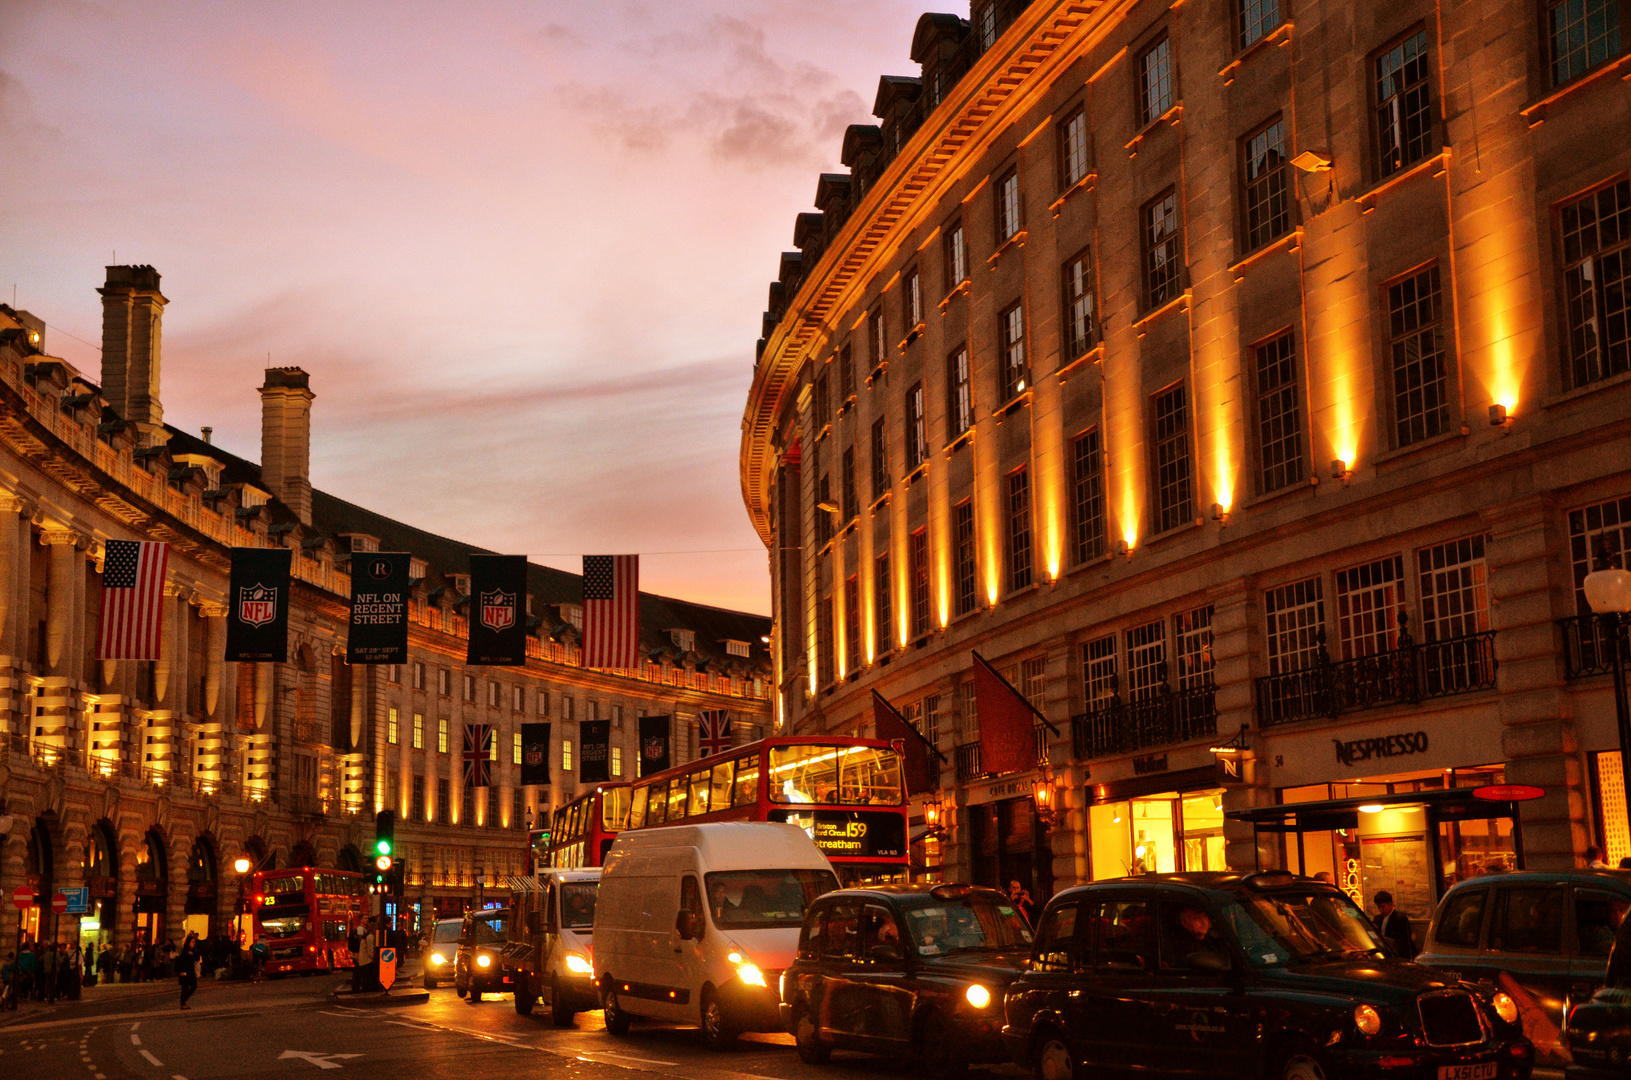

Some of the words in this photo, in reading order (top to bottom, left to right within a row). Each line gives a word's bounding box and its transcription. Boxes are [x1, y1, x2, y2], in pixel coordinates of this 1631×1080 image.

[375, 563, 388, 575] R
[357, 594, 380, 603] NFL
[383, 593, 401, 603] ON
[243, 602, 272, 622] NFL
[353, 604, 403, 613] REGENT
[353, 614, 402, 624] STREET
[484, 607, 512, 627] NFL
[645, 746, 662, 757] NFL
[1332, 731, 1428, 767] NESPRESSO
[527, 752, 541, 761] NFL
[1220, 758, 1239, 778] N
[847, 822, 867, 837] 159
[264, 896, 276, 905] 23
[1474, 1063, 1493, 1079] CTU
